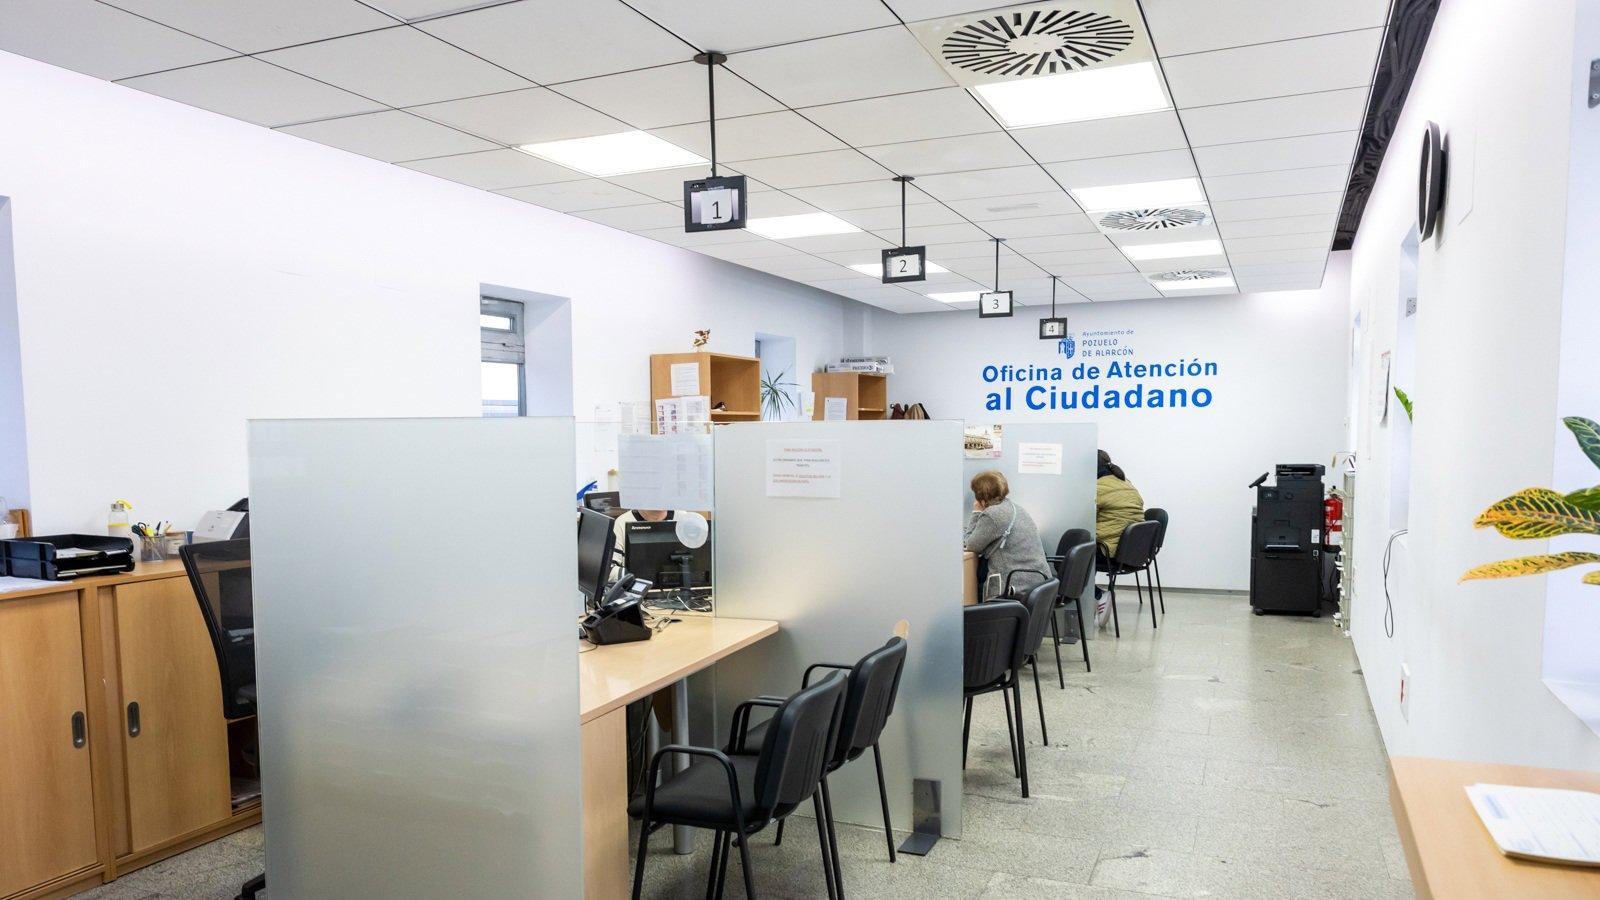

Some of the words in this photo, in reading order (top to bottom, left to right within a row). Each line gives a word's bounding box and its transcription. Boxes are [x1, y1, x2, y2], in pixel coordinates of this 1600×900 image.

[712, 201, 722, 219] 1
[900, 259, 907, 272] 2
[992, 299, 999, 309] 3
[1048, 325, 1054, 333] 4
[1082, 338, 1118, 347] POZUELO
[1095, 346, 1134, 357] ALARCÓN
[982, 364, 1062, 382] Oficina
[1072, 363, 1100, 380] de
[1106, 358, 1218, 378] Atención
[985, 387, 1011, 410] al
[1026, 384, 1213, 410] Ciudadano
